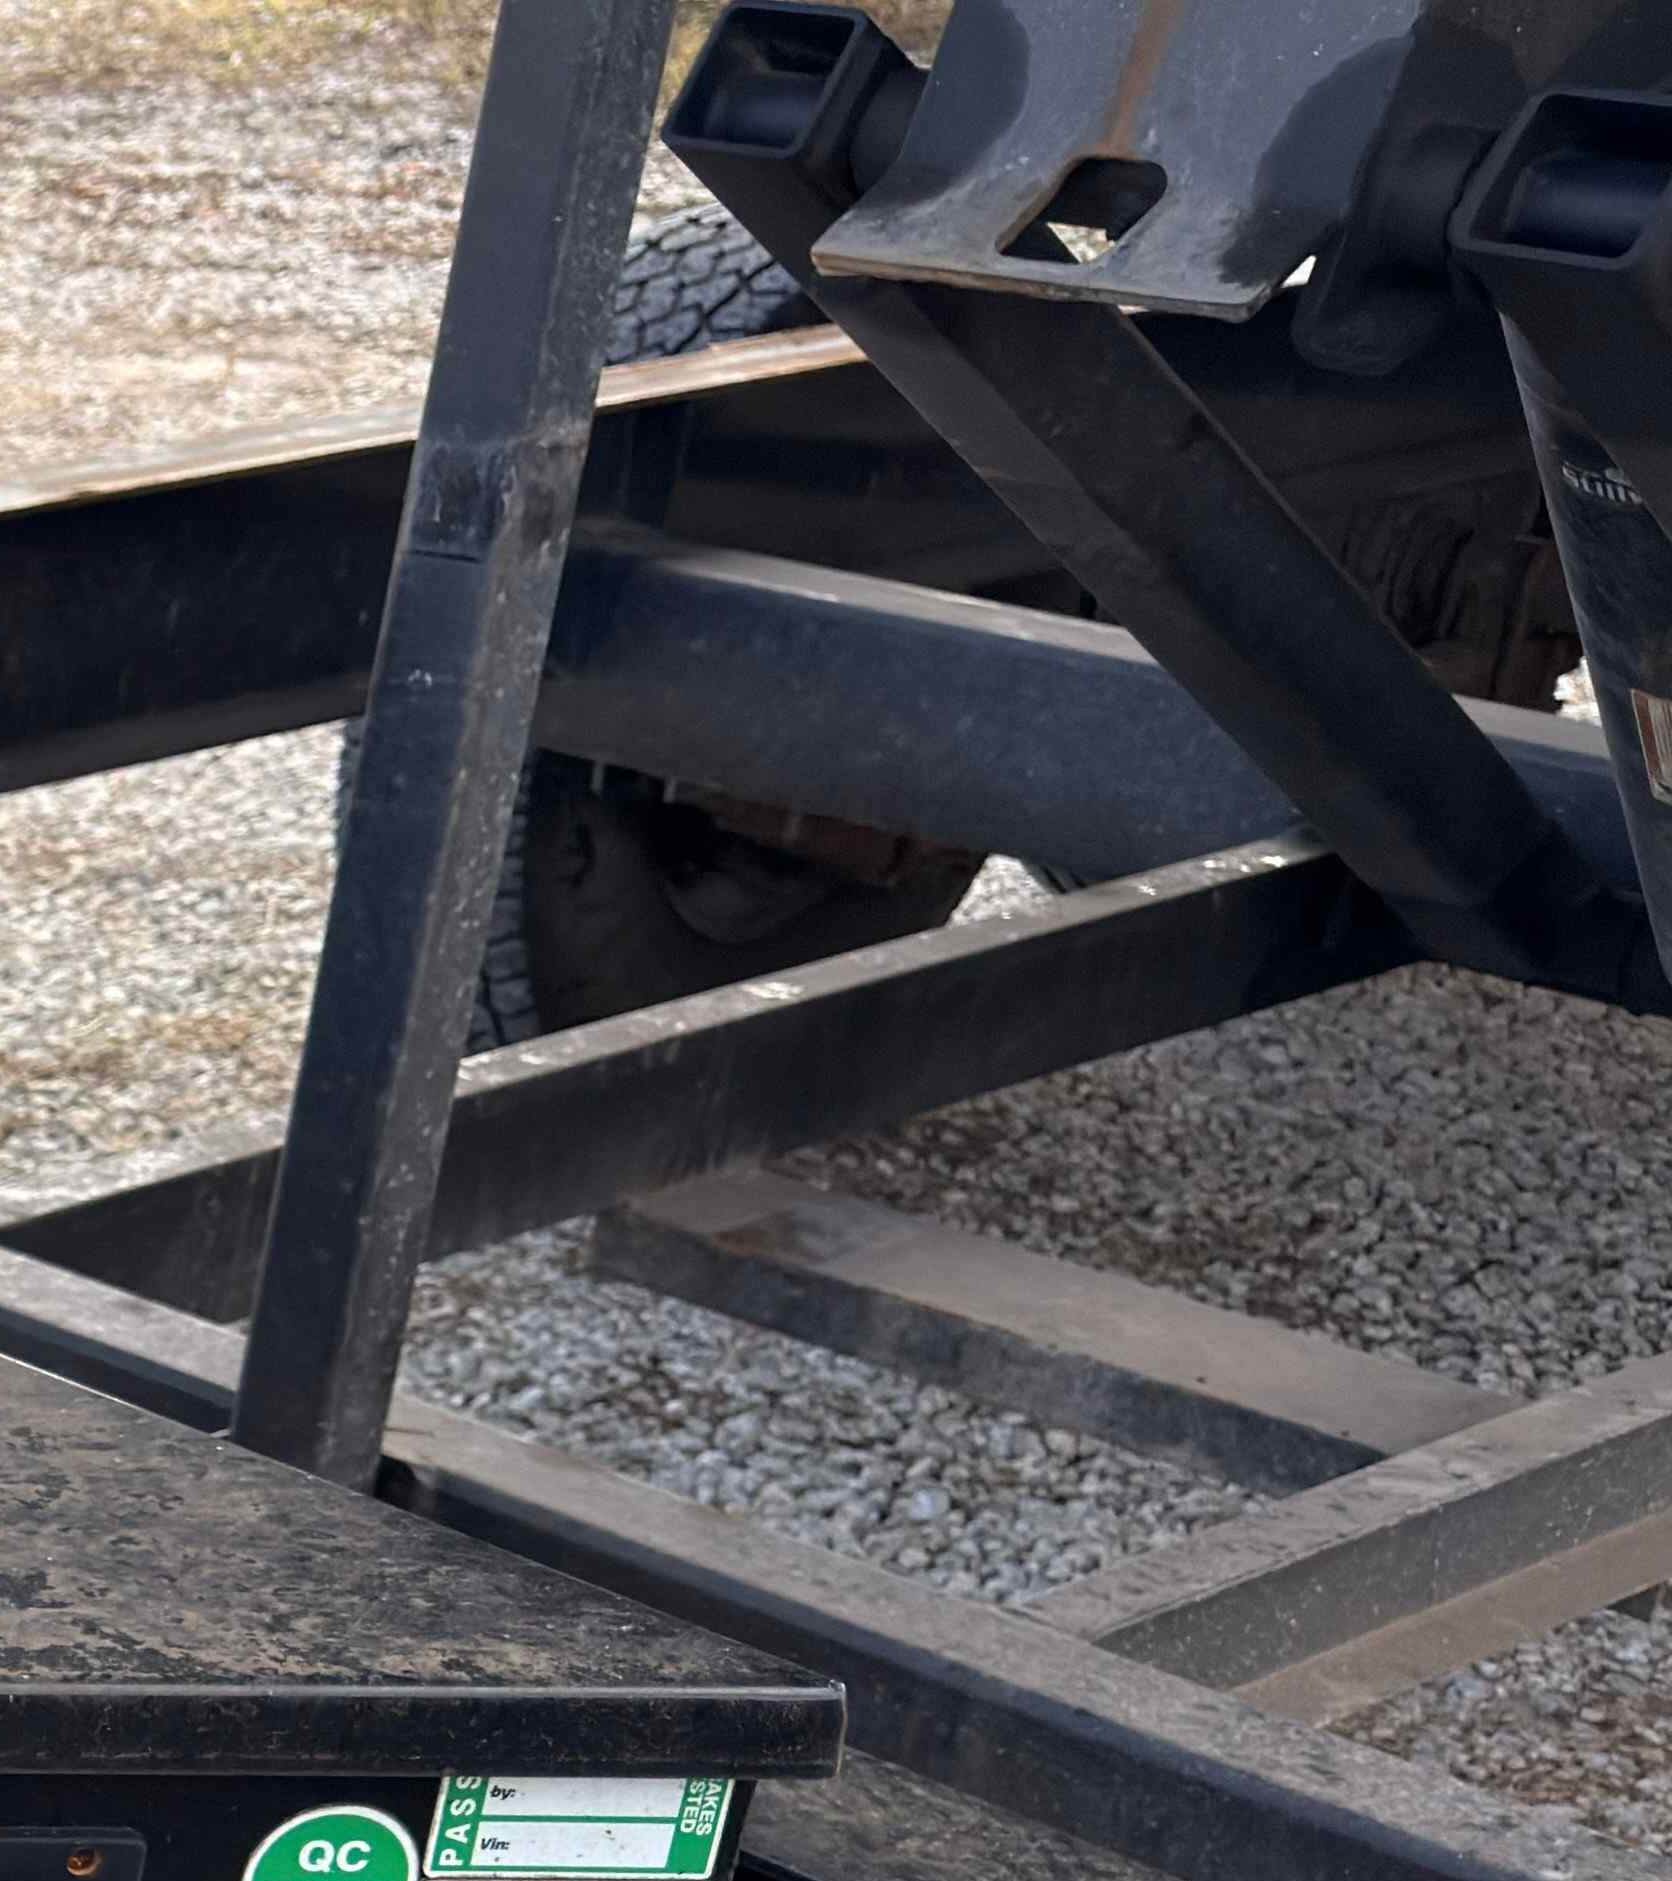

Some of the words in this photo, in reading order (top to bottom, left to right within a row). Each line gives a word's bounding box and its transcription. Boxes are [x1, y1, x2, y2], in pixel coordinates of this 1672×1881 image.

[489, 1785, 516, 1800] by:
[680, 1780, 706, 1833] STED
[695, 1779, 722, 1836] AKES
[438, 1776, 482, 1866] PASS
[298, 1840, 371, 1873] QC
[481, 1838, 510, 1850] Vin:
